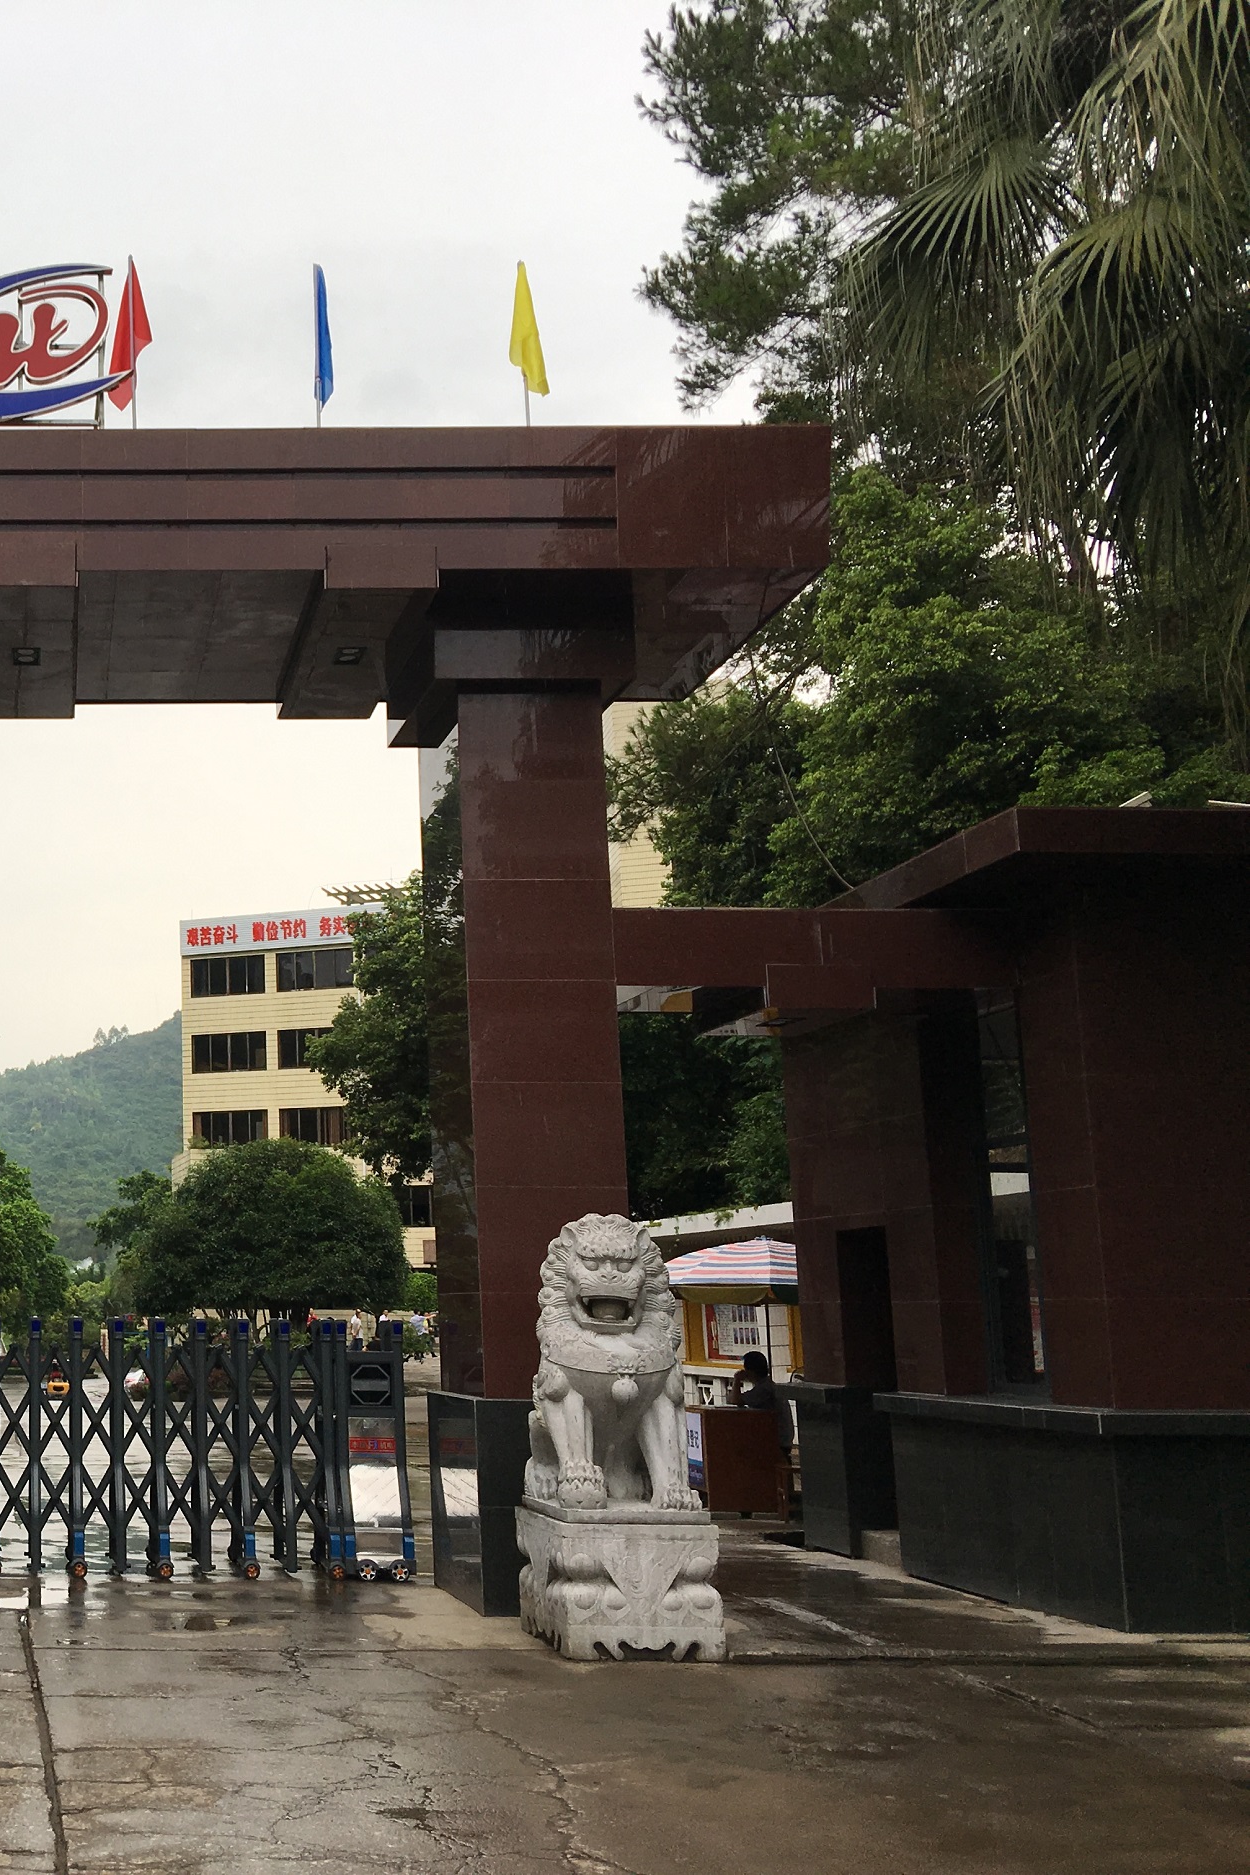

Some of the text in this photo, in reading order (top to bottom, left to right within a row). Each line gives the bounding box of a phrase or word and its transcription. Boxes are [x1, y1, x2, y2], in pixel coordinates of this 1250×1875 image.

[187, 924, 238, 947] 艰苦奋斗
[252, 918, 307, 942] 勤俭节约
